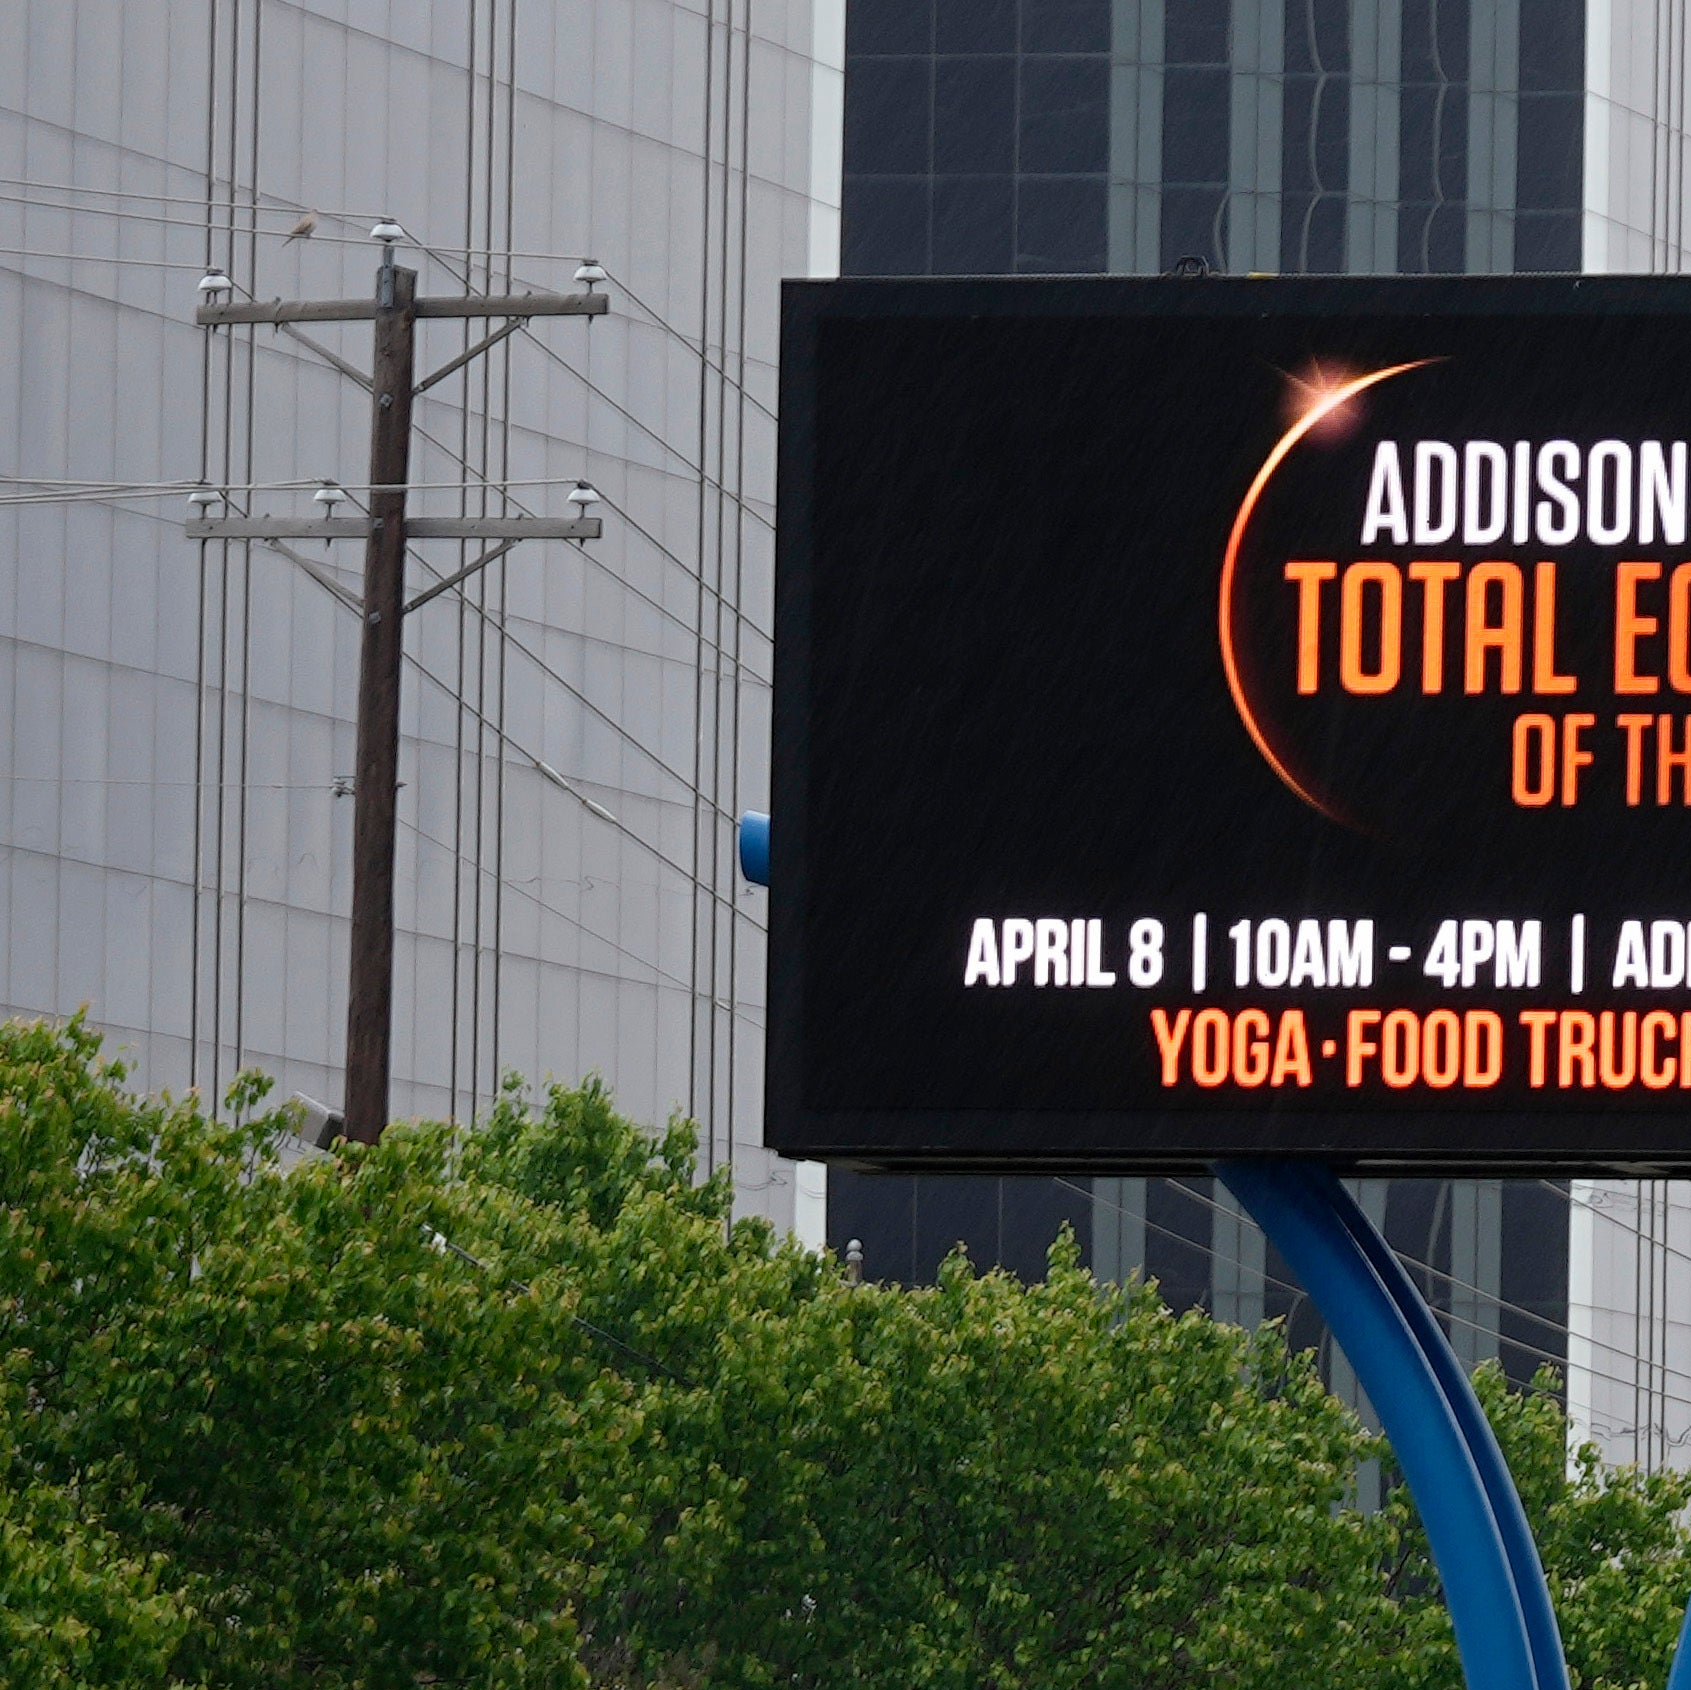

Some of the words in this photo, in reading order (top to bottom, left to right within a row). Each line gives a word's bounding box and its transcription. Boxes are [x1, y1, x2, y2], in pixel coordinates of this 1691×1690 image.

[1359, 439, 1689, 547] ADDISON
[1282, 559, 1579, 697] TOTAL
[1510, 711, 1597, 809] OF
[962, 916, 1118, 988] APRIL
[1126, 916, 1166, 990] 8
[1227, 916, 1375, 990] 10AM
[1421, 918, 1543, 990] 4PM
[1148, 1006, 1315, 1091] YOGA
[1344, 1006, 1505, 1092] FOOD
